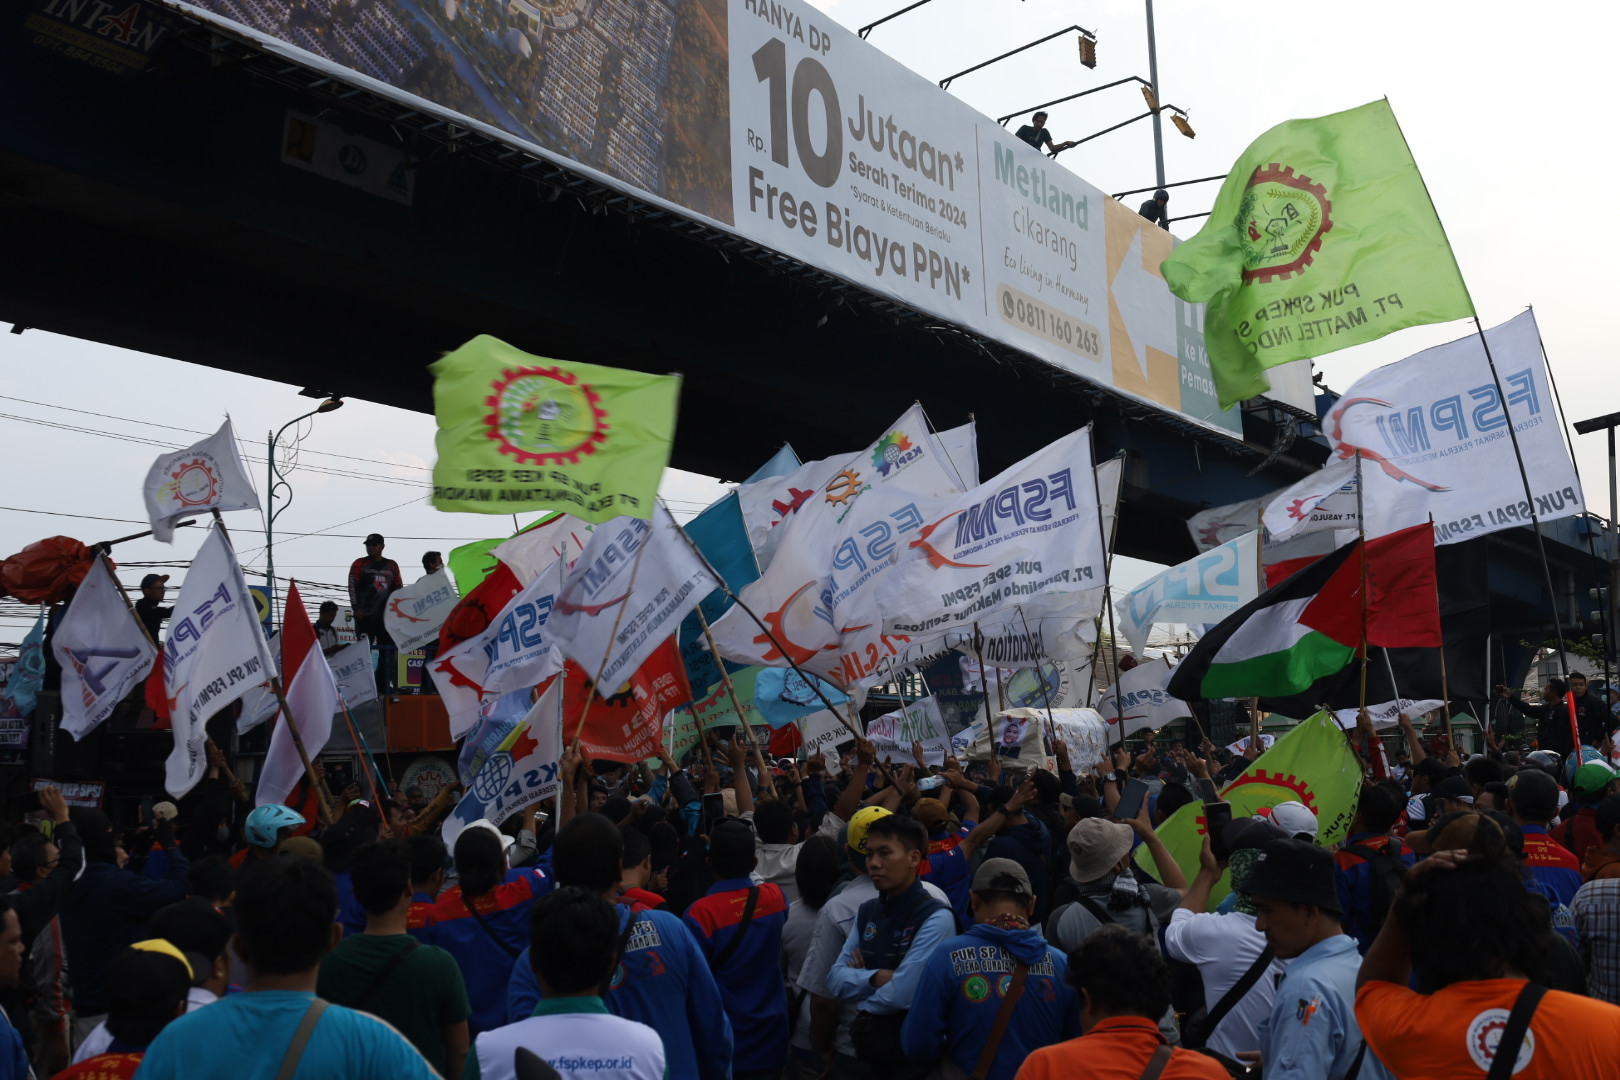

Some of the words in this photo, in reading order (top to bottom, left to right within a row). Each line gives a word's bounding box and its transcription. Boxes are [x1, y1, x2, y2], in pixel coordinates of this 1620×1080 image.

[809, 24, 831, 55] DP
[747, 128, 767, 153] Rp.
[751, 37, 843, 188] 10
[849, 152, 889, 190] Serah
[891, 173, 936, 214] Terima
[938, 198, 967, 229] 2024
[994, 140, 1089, 232] Metland
[748, 165, 818, 238] Free
[826, 201, 907, 277] Biaya
[886, 204, 924, 231] Ketentuan
[925, 222, 951, 244] Berlaku
[1013, 205, 1077, 271] cikarang
[1004, 246, 1017, 270] Eco
[1055, 273, 1089, 316] Harmony
[1016, 298, 1046, 334] 0811
[1049, 313, 1072, 344] 160
[1075, 326, 1099, 357] 263
[1184, 338, 1196, 363] ke
[950, 945, 978, 964] PUK
[981, 945, 998, 961] SP
[966, 961, 981, 975] EKA
